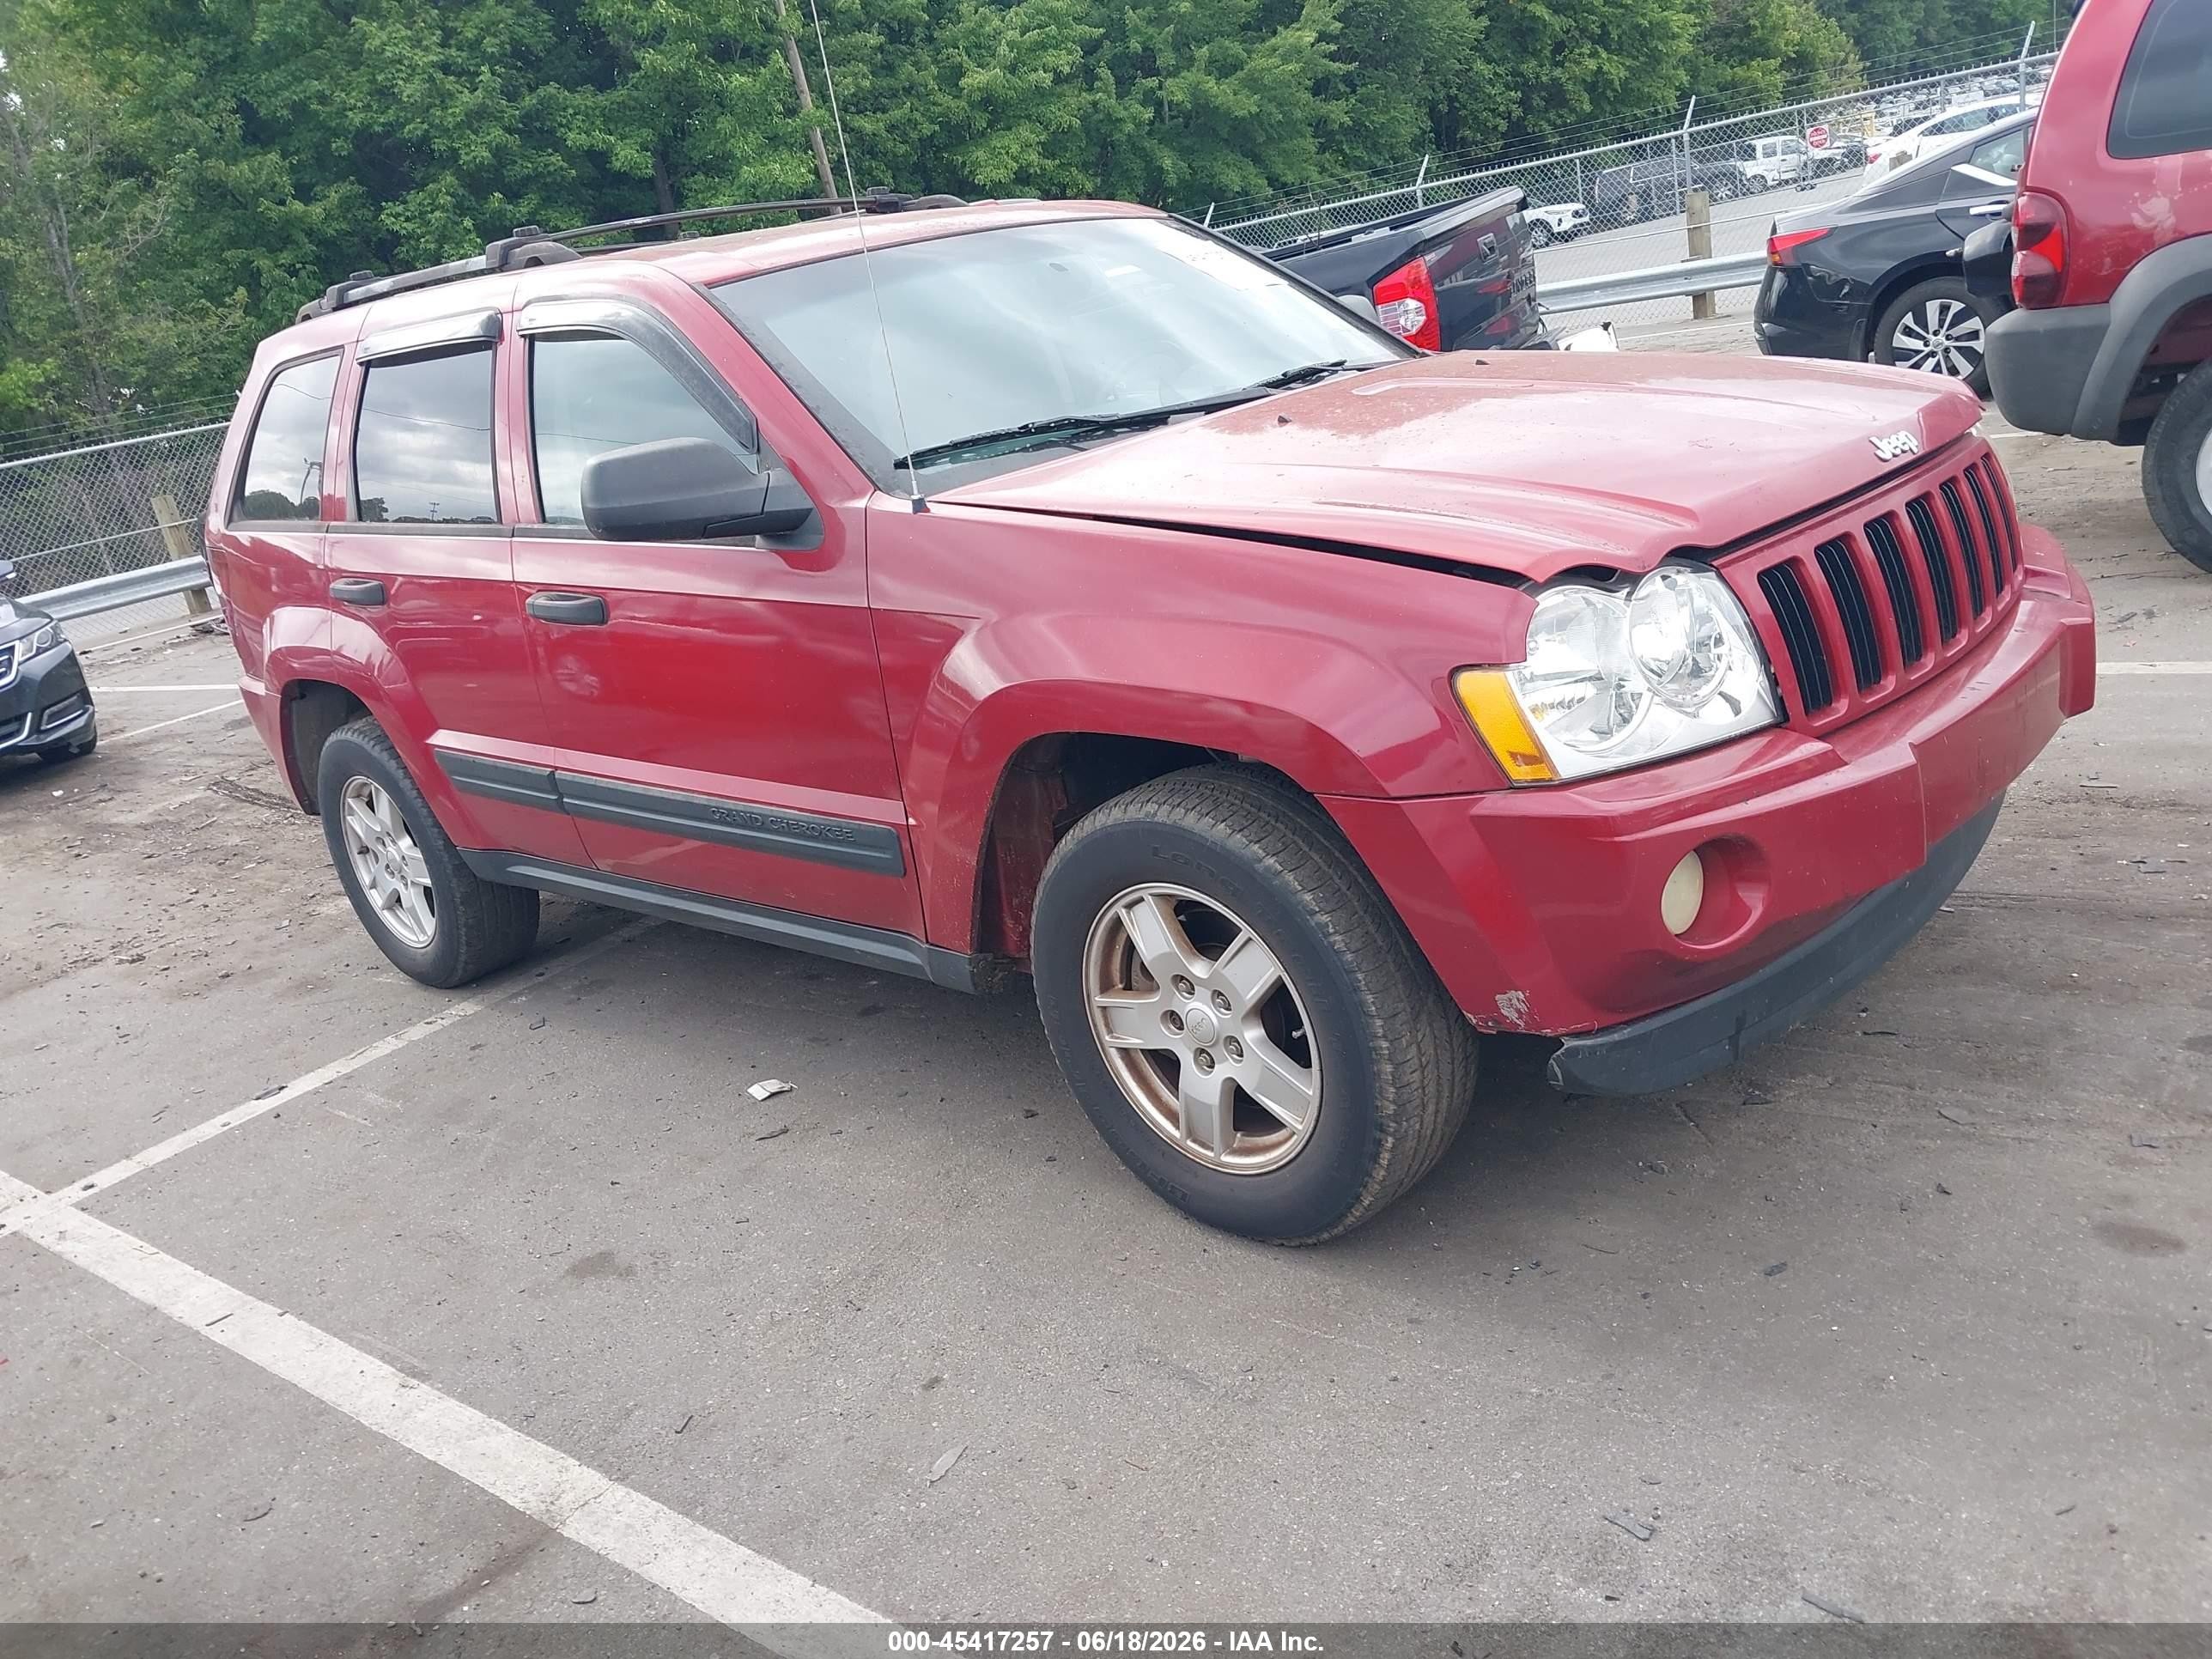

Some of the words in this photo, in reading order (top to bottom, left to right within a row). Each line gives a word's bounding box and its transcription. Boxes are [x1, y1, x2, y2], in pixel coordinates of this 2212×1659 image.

[1869, 430, 1919, 462] Jeep
[709, 807, 764, 826] GRAND
[769, 817, 857, 842] CHEROKEE
